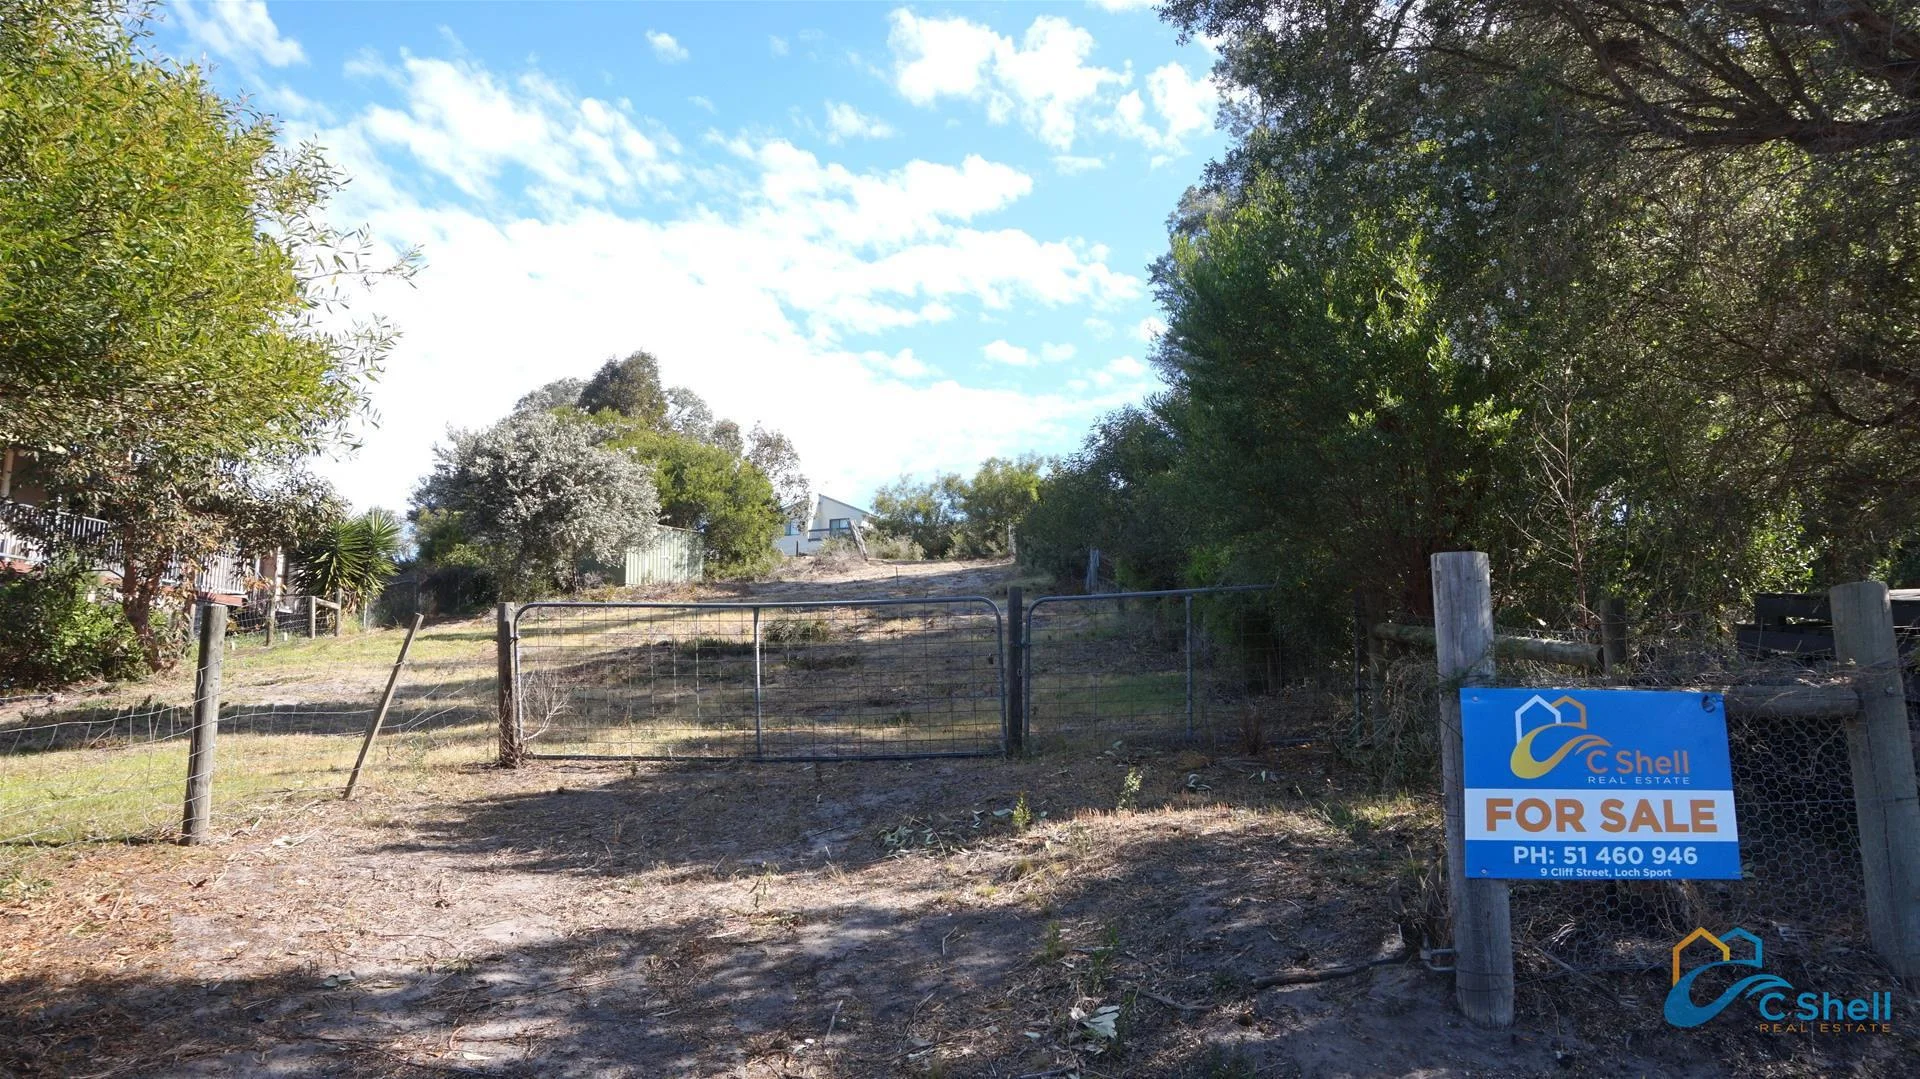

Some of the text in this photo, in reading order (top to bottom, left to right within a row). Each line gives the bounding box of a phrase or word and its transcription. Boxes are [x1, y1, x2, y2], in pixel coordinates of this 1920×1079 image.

[1586, 749, 1690, 775] C Shell
[1587, 776, 1690, 785] REAL ESTATE
[1485, 797, 1718, 833] FOR SALE
[1513, 846, 1698, 865] PH: 51 460 946
[1540, 867, 1672, 879] 9 Cliff Street, Loch Sport
